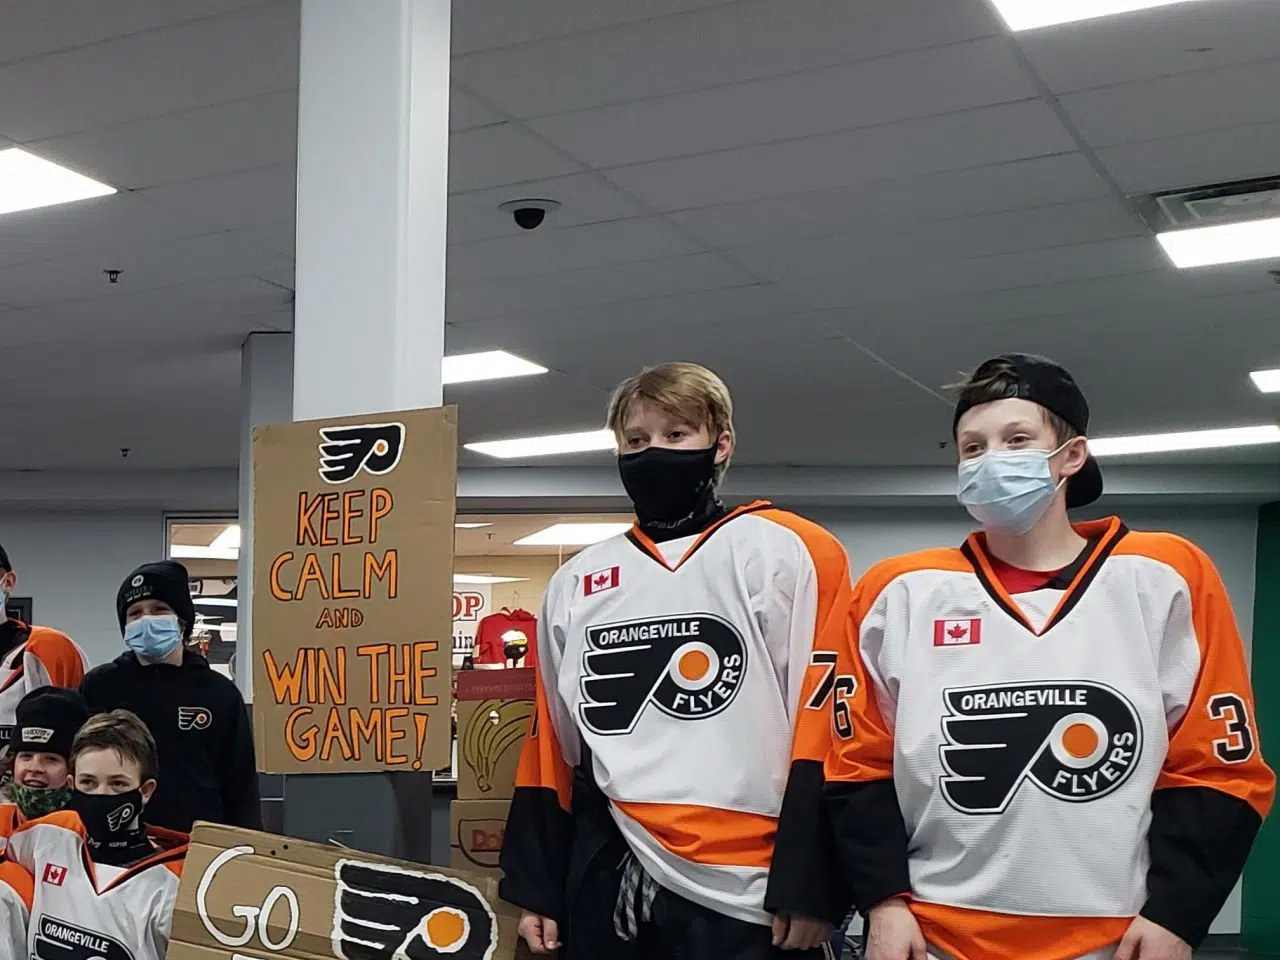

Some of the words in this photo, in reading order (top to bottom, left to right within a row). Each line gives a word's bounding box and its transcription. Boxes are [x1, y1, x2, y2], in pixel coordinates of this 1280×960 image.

[297, 487, 393, 546] KEEP
[270, 549, 397, 601] CALM
[315, 607, 363, 628] AND
[452, 594, 481, 618] OP
[599, 621, 700, 645] ORANGEVILLE
[263, 646, 346, 705] WIN
[357, 641, 438, 705] THE
[672, 653, 741, 712] FLYERS
[961, 689, 1087, 710] ORANGEVILLE
[284, 706, 428, 770] GAME!
[1209, 693, 1255, 764] 3
[1052, 731, 1134, 793] FLYERS
[196, 845, 300, 951] GO
[45, 922, 110, 953] ORANGEVILLE
